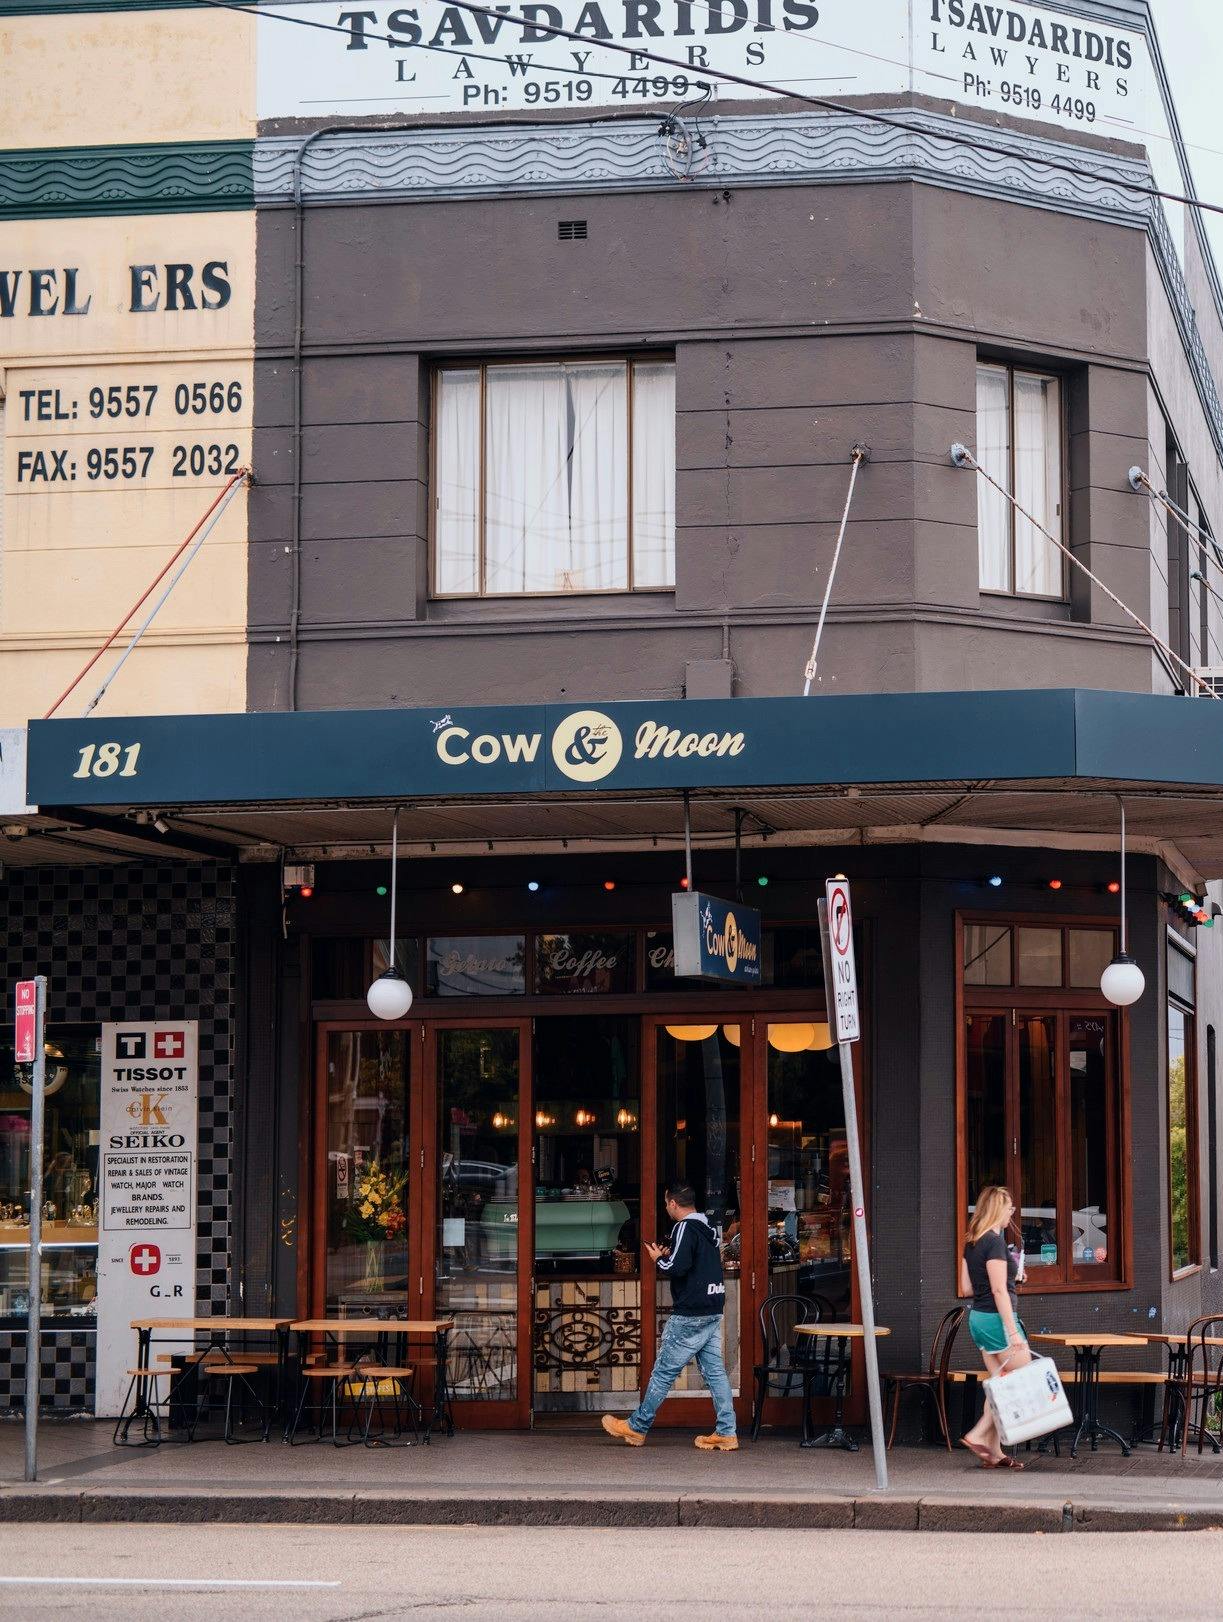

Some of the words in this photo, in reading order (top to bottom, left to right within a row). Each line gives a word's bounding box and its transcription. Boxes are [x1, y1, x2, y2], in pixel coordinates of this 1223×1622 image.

[338, 0, 820, 51] TSAVDARIDIS
[395, 41, 767, 83] LAWYERS
[931, 32, 1129, 97] LAWYERS
[462, 83, 509, 106] Ph:
[523, 79, 593, 104] 9519
[611, 74, 689, 98] 4499
[963, 72, 991, 98] Ph:
[1000, 80, 1042, 110] 9519
[1051, 93, 1097, 123] 4499
[128, 260, 233, 313] ERS
[19, 388, 78, 421] TEL:
[89, 385, 159, 419] 9557
[175, 381, 243, 415] 0566
[17, 450, 76, 482] FAX:
[86, 447, 155, 480] 9557
[172, 443, 240, 477] 2032
[436, 726, 542, 766] Cow
[633, 720, 746, 759] Moon
[72, 742, 141, 778] 181
[706, 924, 725, 957] Cow
[737, 928, 757, 962] Moon
[549, 949, 618, 977] Coffee
[837, 960, 851, 984] NO
[21, 988, 30, 1000] NO
[837, 989, 855, 1008] RIGHT
[16, 1005, 35, 1016] STOPPING
[840, 1013, 857, 1031] TURN
[113, 1067, 187, 1081] TISSOT
[109, 1134, 186, 1149] SEIKO
[107, 1156, 138, 1165] SPECIALIST
[140, 1156, 147, 1164] IN
[147, 1155, 189, 1164] RESTORATION
[107, 1169, 127, 1177] REPAIR
[128, 1169, 134, 1177] &
[135, 1169, 153, 1177] SALES
[163, 1168, 189, 1176] VINTAGE
[111, 1181, 134, 1190] WATCH,
[135, 1181, 157, 1190] MAJOR
[162, 1180, 185, 1189] WATCH
[110, 1205, 144, 1215] JEWELLERY
[145, 1205, 170, 1213] REPAIRS
[171, 1204, 186, 1213] AND
[131, 1193, 165, 1202] BRANDS.
[125, 1217, 169, 1226] REMODELING.
